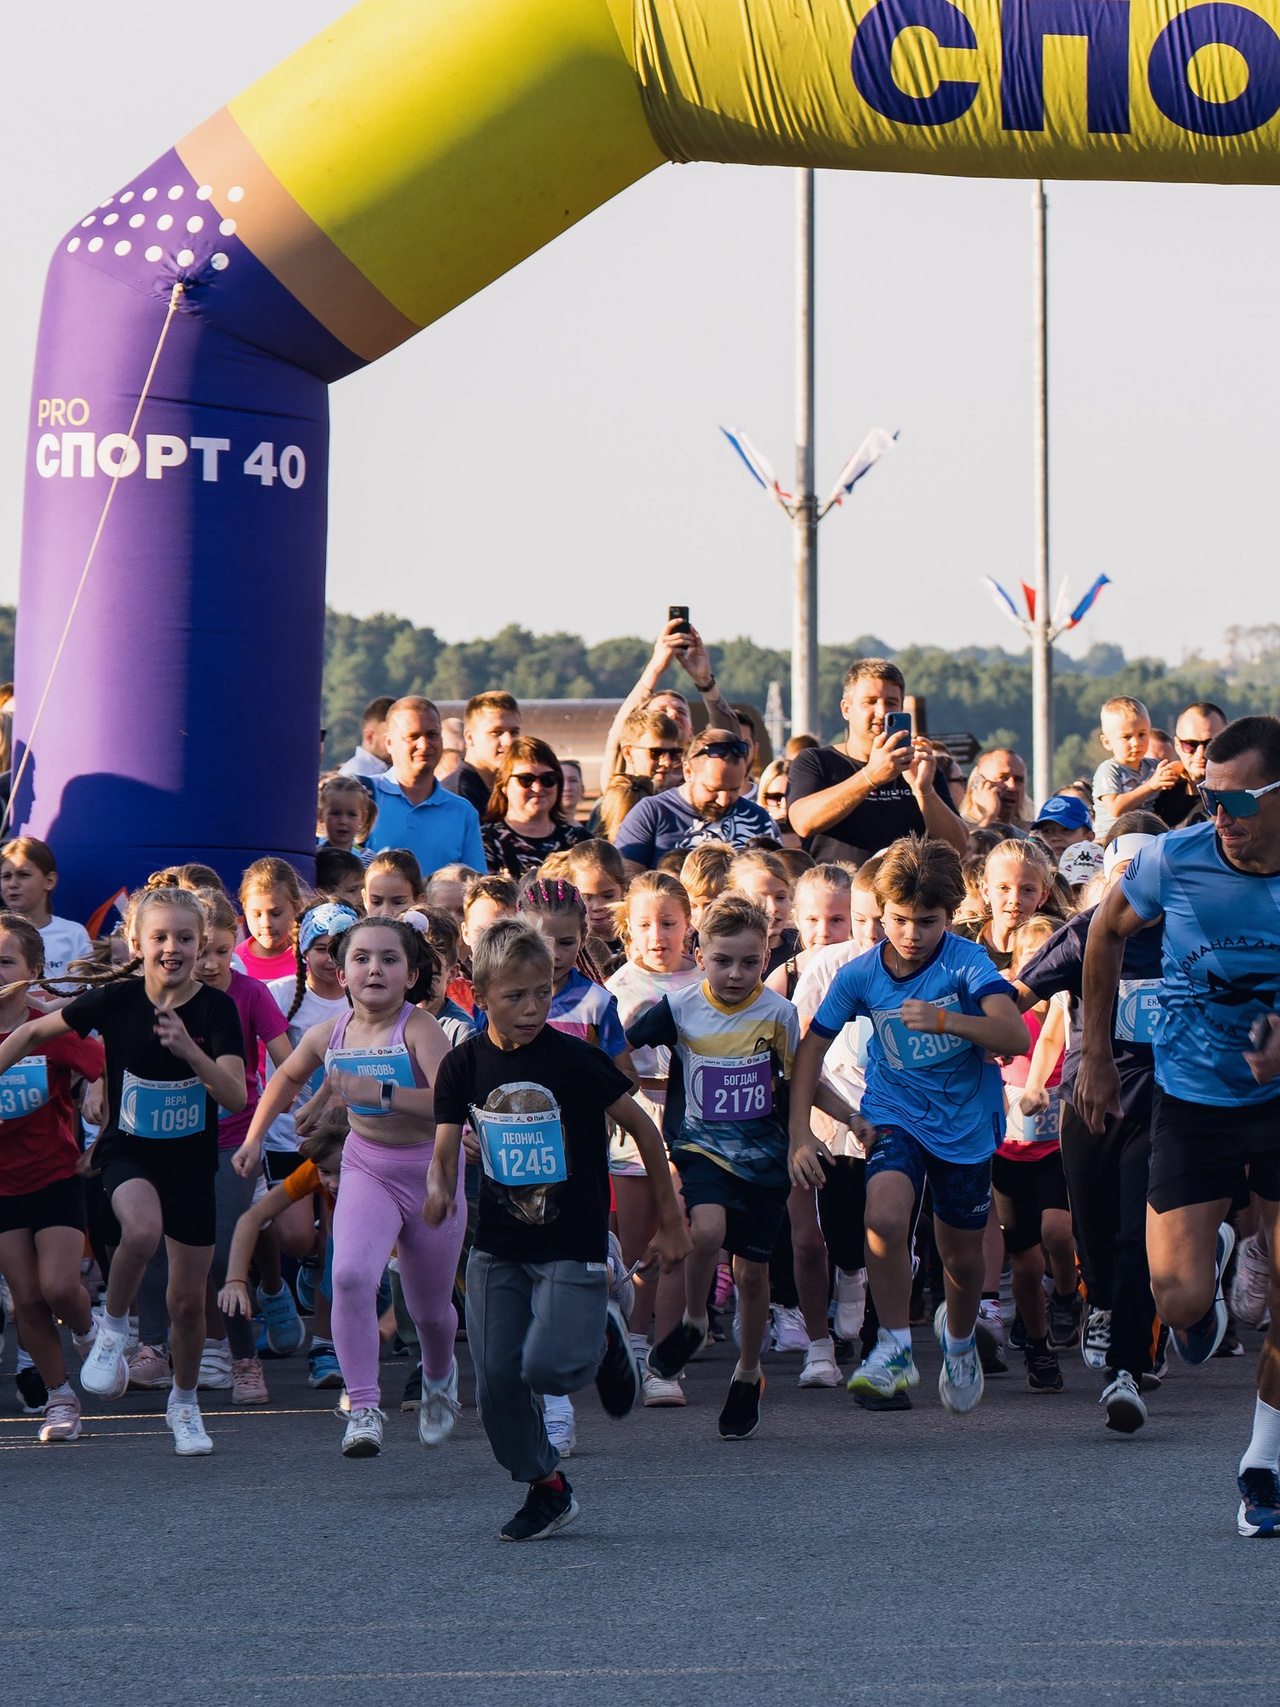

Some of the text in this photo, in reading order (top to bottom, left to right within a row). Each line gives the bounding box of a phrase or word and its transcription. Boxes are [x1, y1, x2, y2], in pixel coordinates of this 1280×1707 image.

[37, 398, 90, 428] PRO
[35, 432, 306, 489] СПОРТ 40
[1181, 935, 1248, 972] ОМАНДА
[357, 1064, 395, 1076] ЛЮБОВЬ
[724, 1072, 757, 1086] БОГДАН
[0, 1088, 42, 1113] 319
[165, 1095, 186, 1106] ВЕРА
[715, 1085, 765, 1113] 2178
[151, 1104, 199, 1132] 1099
[502, 1131, 544, 1145] ЛЕОНИД
[499, 1146, 557, 1177] 1245
